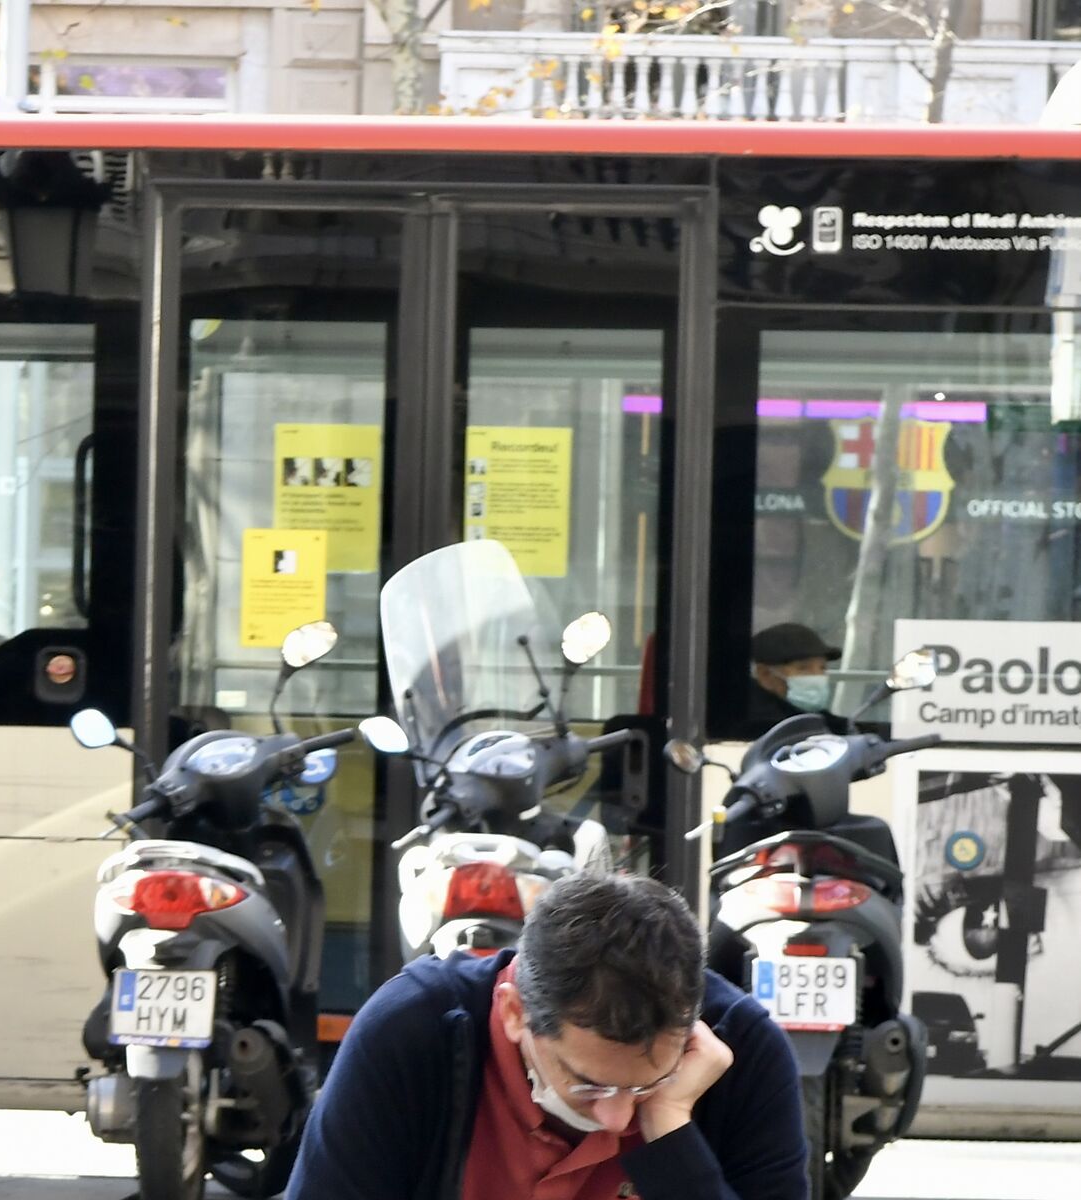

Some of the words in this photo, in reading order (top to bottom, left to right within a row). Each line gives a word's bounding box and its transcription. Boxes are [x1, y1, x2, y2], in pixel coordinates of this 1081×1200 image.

[852, 211, 950, 230] Respectem
[972, 212, 1017, 229] Medi
[852, 233, 883, 250] ISO
[884, 234, 928, 250] 14001
[755, 493, 806, 511] LONA
[967, 499, 1049, 519] OFFICIAL
[920, 643, 1081, 696] Paolo
[919, 701, 996, 728] Camp
[1001, 702, 1081, 727] d'imat
[137, 975, 207, 1002] 2796
[778, 963, 848, 989] 8589
[776, 992, 828, 1018] LFR
[135, 1006, 188, 1033] HYM
